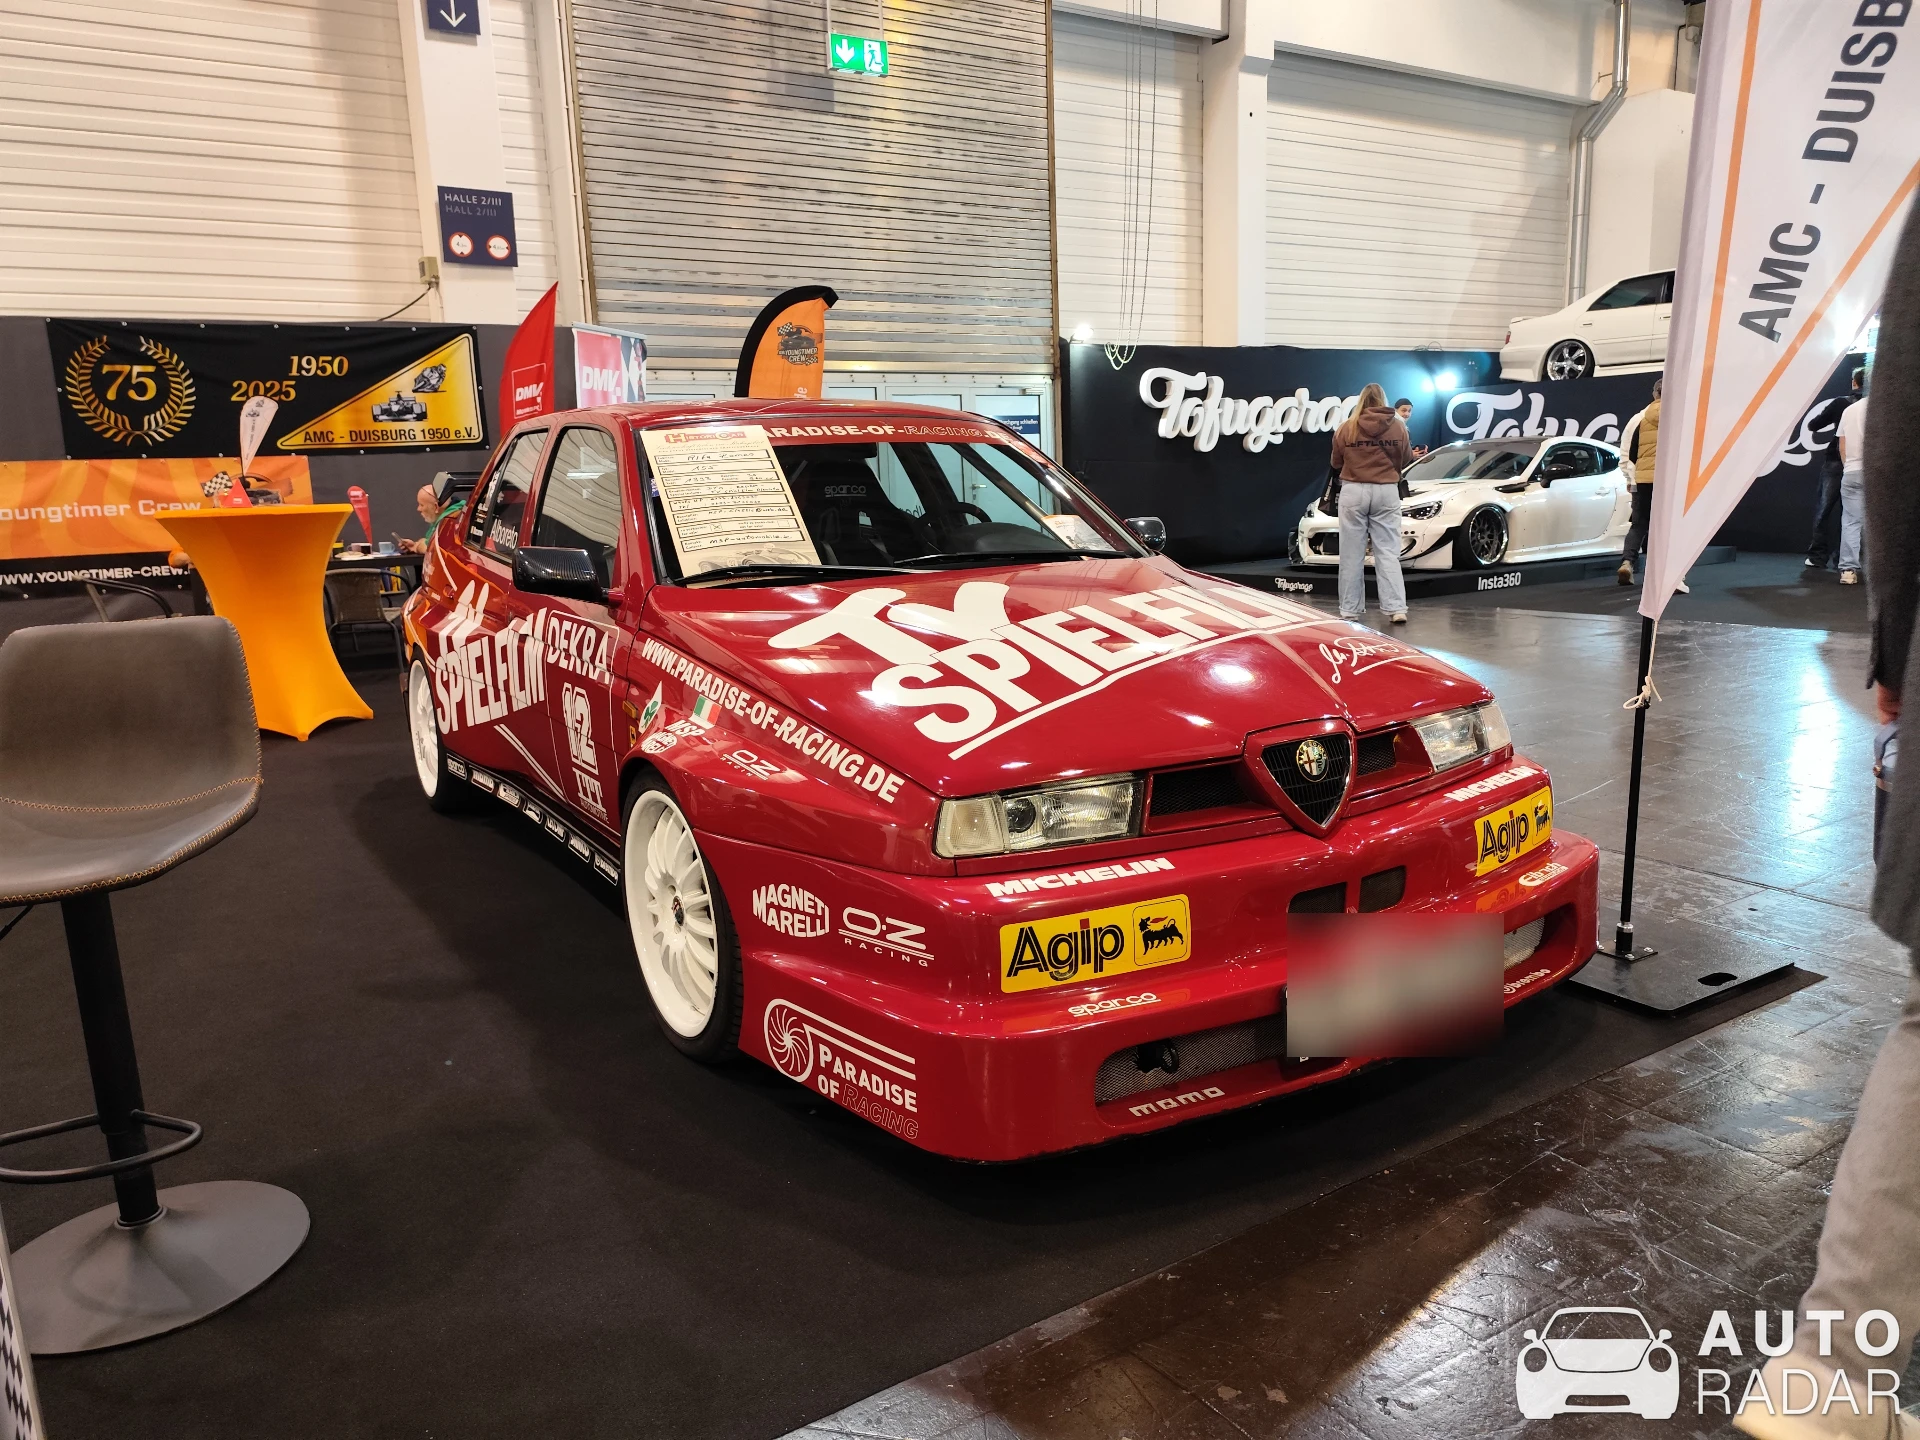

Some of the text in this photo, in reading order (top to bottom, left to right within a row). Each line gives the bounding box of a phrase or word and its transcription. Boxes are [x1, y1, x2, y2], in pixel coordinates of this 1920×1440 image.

[444, 193, 478, 204] HALLE
[445, 205, 473, 215] HALL
[1738, 222, 1821, 343] AMC
[102, 364, 157, 401] 75
[288, 355, 349, 377] 1950
[230, 380, 296, 402] 2025
[303, 430, 335, 443] AMC
[349, 428, 416, 442] DUISBURG
[420, 427, 450, 440] 1950
[454, 426, 476, 438] e.V.
[824, 484, 867, 499] sparco
[490, 518, 519, 549] Alboreto
[1275, 577, 1313, 593] Tofugarage
[1478, 571, 1522, 591] Insta360
[548, 616, 610, 685] DEKRA
[435, 607, 547, 735] SPIELFILM
[562, 681, 599, 776] 12
[641, 638, 905, 804] WWW.PARADISE-OF-RACING.DE
[1445, 766, 1539, 802] MICHELIN
[1479, 809, 1530, 864] Agip
[984, 857, 1176, 898] MICHELIN
[752, 883, 830, 922] MAGNETI
[752, 898, 830, 938] MARELLI
[844, 937, 929, 968] RACING
[1006, 917, 1126, 982] Agip
[1068, 991, 1162, 1018] sparco
[819, 1043, 918, 1114] PARADISE
[817, 1075, 919, 1140] OF RACING
[1128, 1086, 1225, 1118] momo
